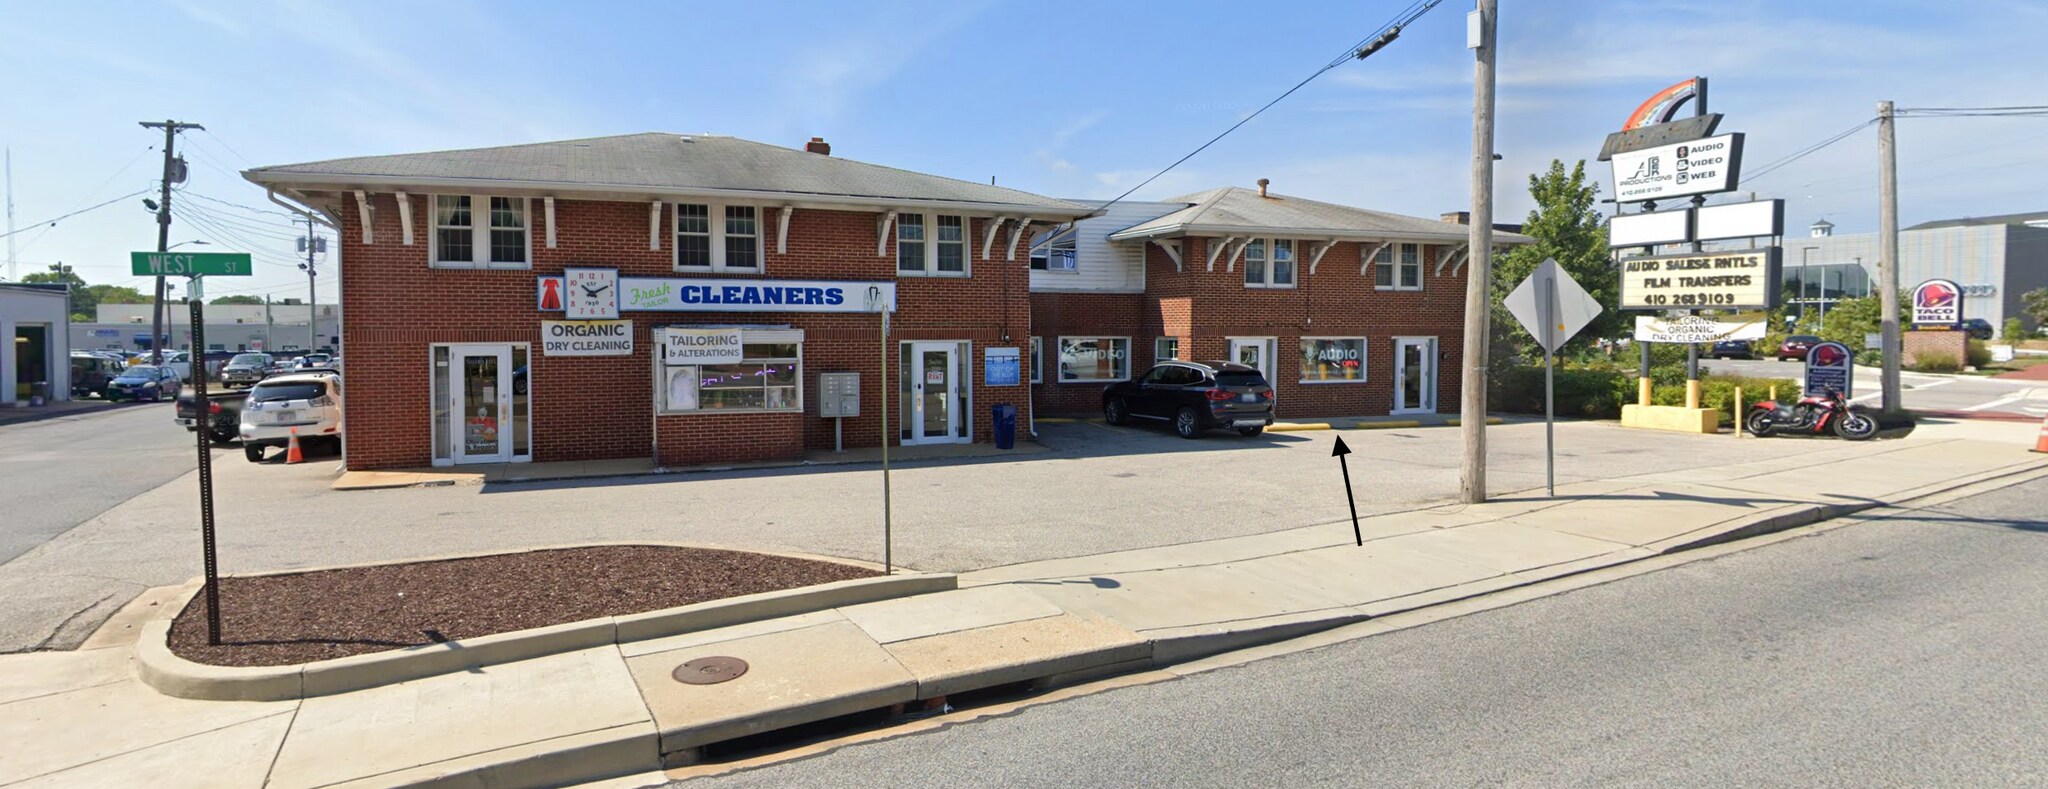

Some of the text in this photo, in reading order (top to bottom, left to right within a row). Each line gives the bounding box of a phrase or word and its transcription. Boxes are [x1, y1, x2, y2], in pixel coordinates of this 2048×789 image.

[1691, 142, 1724, 154] AUDIO
[1690, 156, 1723, 167] VIDEO
[1619, 174, 1673, 187] PRODUCTIONS
[1691, 170, 1716, 180] WEB
[148, 255, 237, 274] WEST ST
[1626, 261, 1660, 272] AUDIO
[1714, 256, 1758, 269] RNTLS
[1644, 275, 1752, 288] FILM TRANSFERS
[630, 282, 671, 305] Fresh
[680, 285, 844, 305] CLEANERS
[1644, 294, 1666, 305] 410
[641, 297, 670, 309] TAILOR
[551, 324, 625, 337] ORGANIC
[1668, 325, 1715, 334] ORGANIC
[669, 335, 739, 346] TAILORING
[1676, 332, 1732, 341] CLEANING
[546, 340, 631, 351] DRY CLEANING
[669, 348, 740, 358] & ALTERATIONS
[1318, 348, 1358, 360] AUDIO
